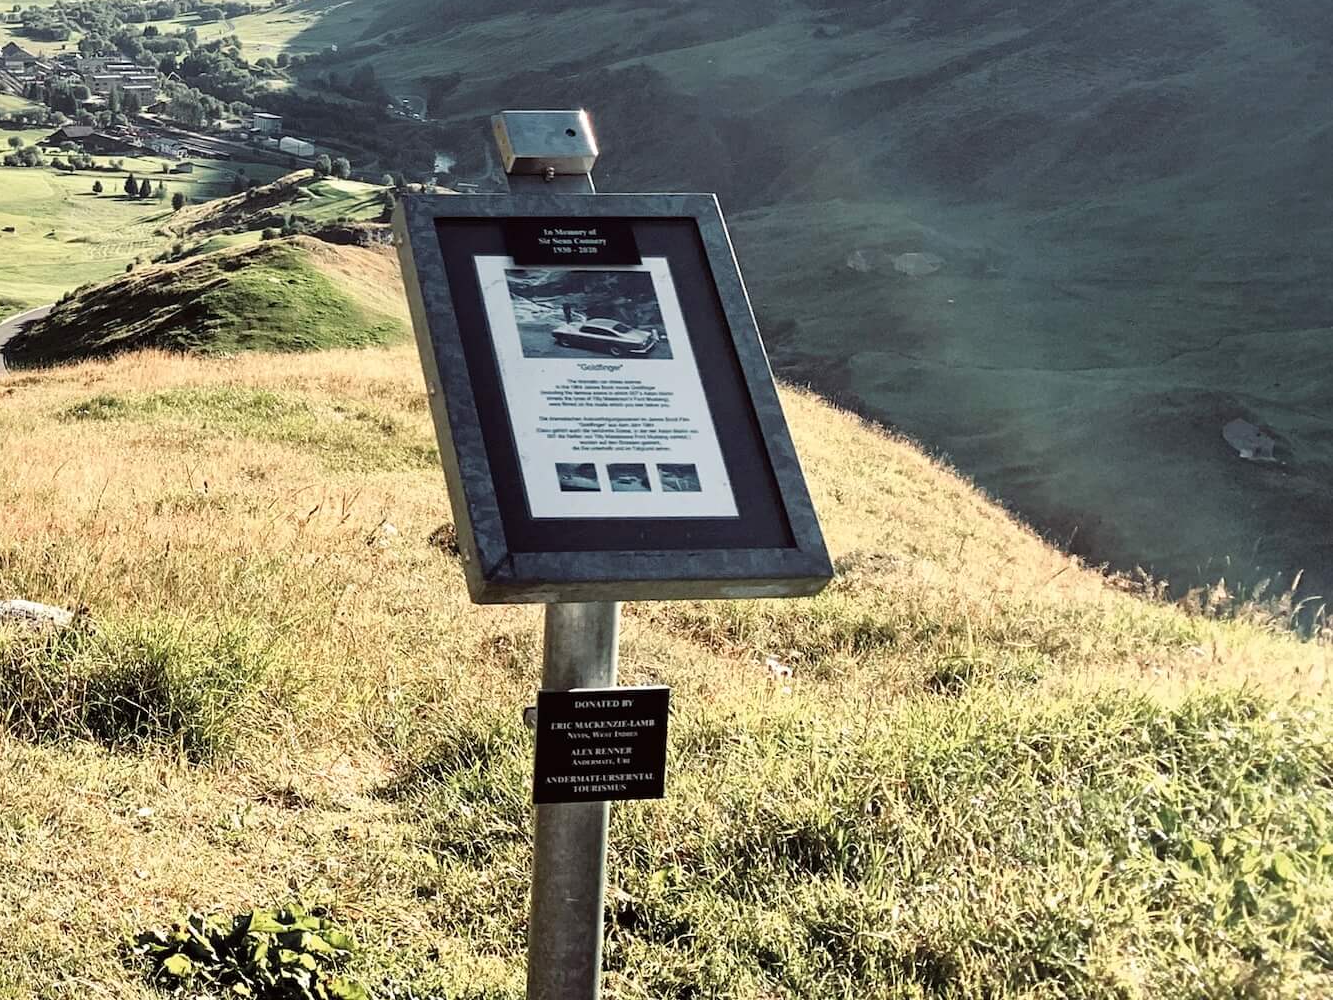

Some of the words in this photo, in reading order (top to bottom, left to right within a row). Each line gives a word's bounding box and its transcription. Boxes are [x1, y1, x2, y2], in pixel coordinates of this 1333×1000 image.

[574, 700, 620, 709] DONATED
[621, 699, 635, 708] BY
[550, 721, 573, 731] ERIC
[574, 719, 656, 730] MACKENZIE-LAMB
[571, 748, 593, 756] ALEX
[595, 747, 633, 755] RENNER
[546, 773, 654, 784] ANDERMATT-URSERNTAL
[573, 784, 627, 793] TOURISMUS
